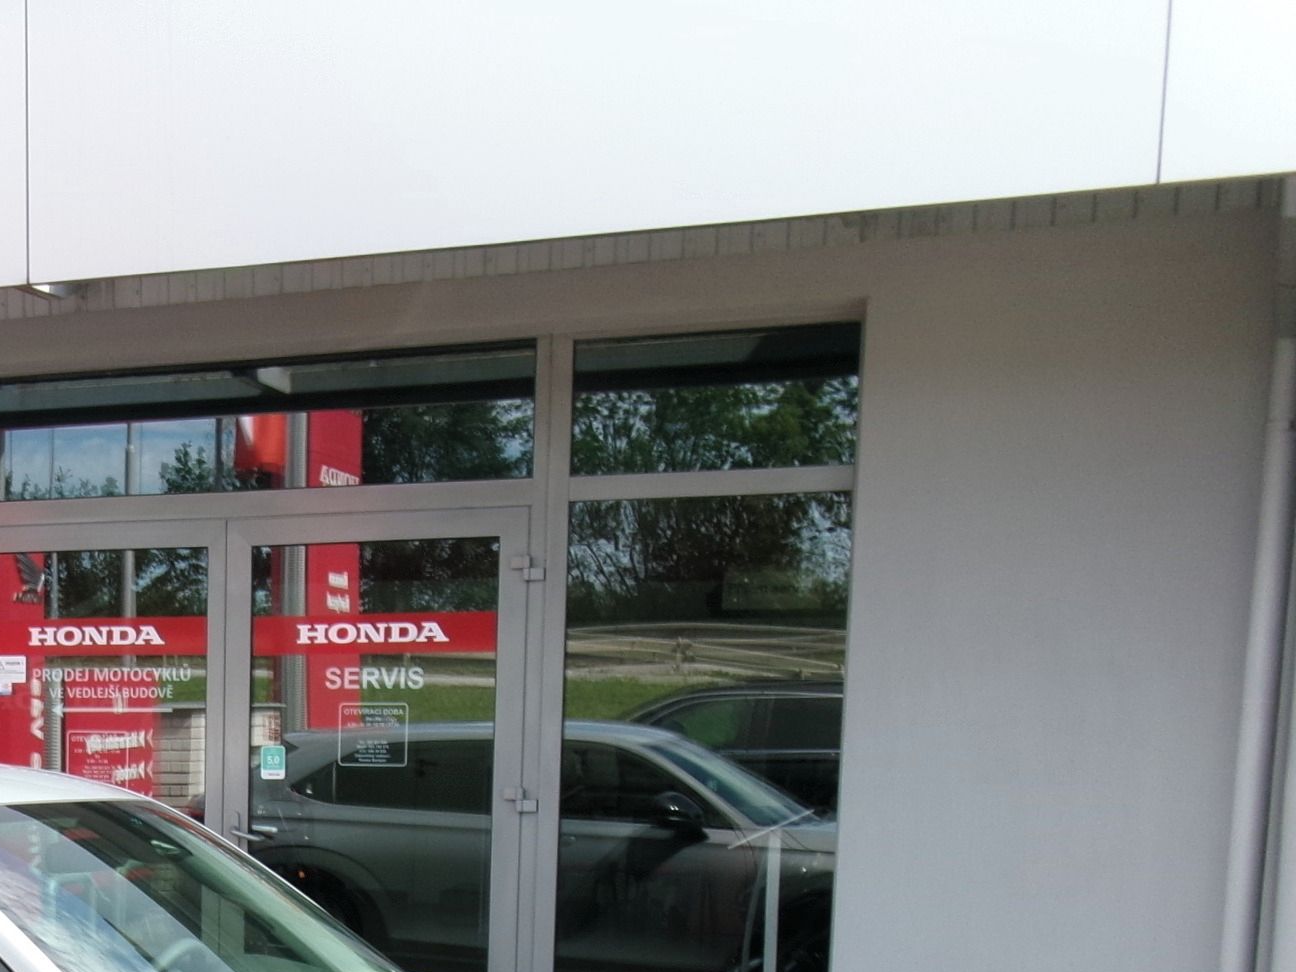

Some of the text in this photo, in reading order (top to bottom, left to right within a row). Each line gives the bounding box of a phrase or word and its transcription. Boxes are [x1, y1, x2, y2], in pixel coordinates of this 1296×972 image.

[29, 626, 165, 646] HONDA
[296, 622, 449, 644] HONDA
[32, 667, 89, 683] PRODEJ
[93, 663, 192, 683] MOTOCYKLŮ
[325, 666, 425, 691] SERVIS
[49, 687, 64, 699] VE
[122, 684, 174, 699] BUDOVĚ
